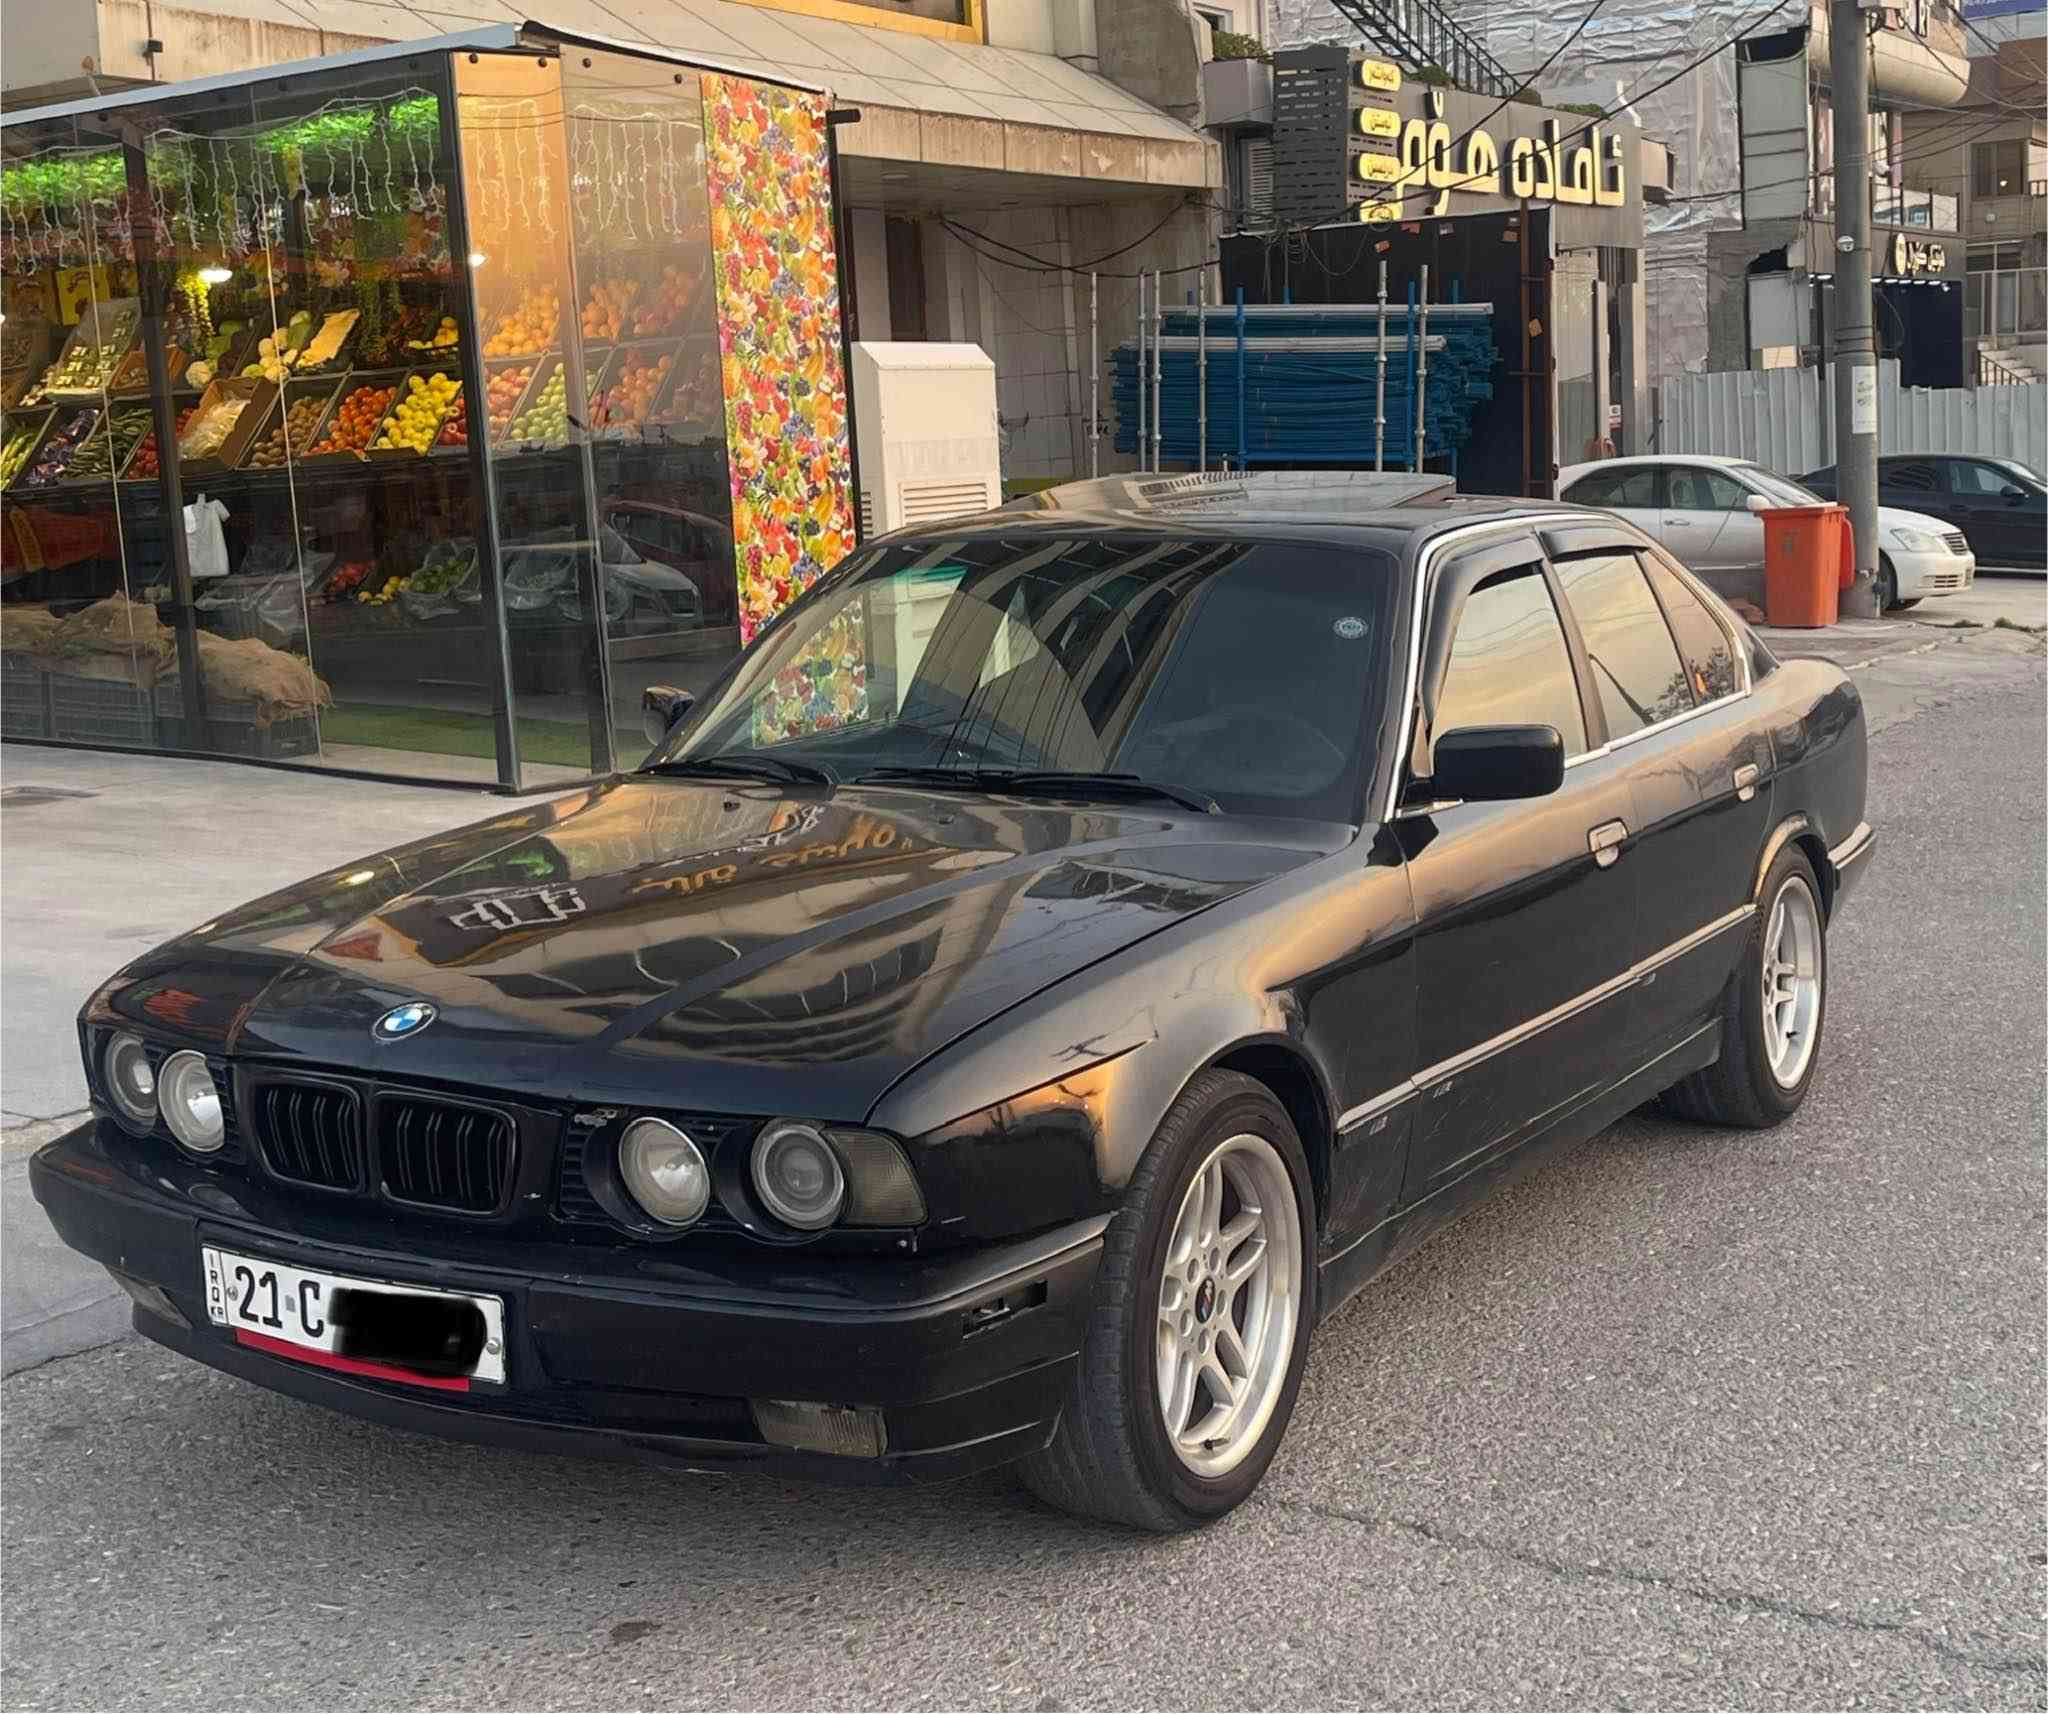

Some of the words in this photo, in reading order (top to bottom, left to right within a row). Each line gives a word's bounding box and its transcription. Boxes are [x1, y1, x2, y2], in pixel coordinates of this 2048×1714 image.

[209, 1251, 221, 1303] IRQ
[234, 1265, 283, 1329] 21
[299, 1279, 325, 1338] C
